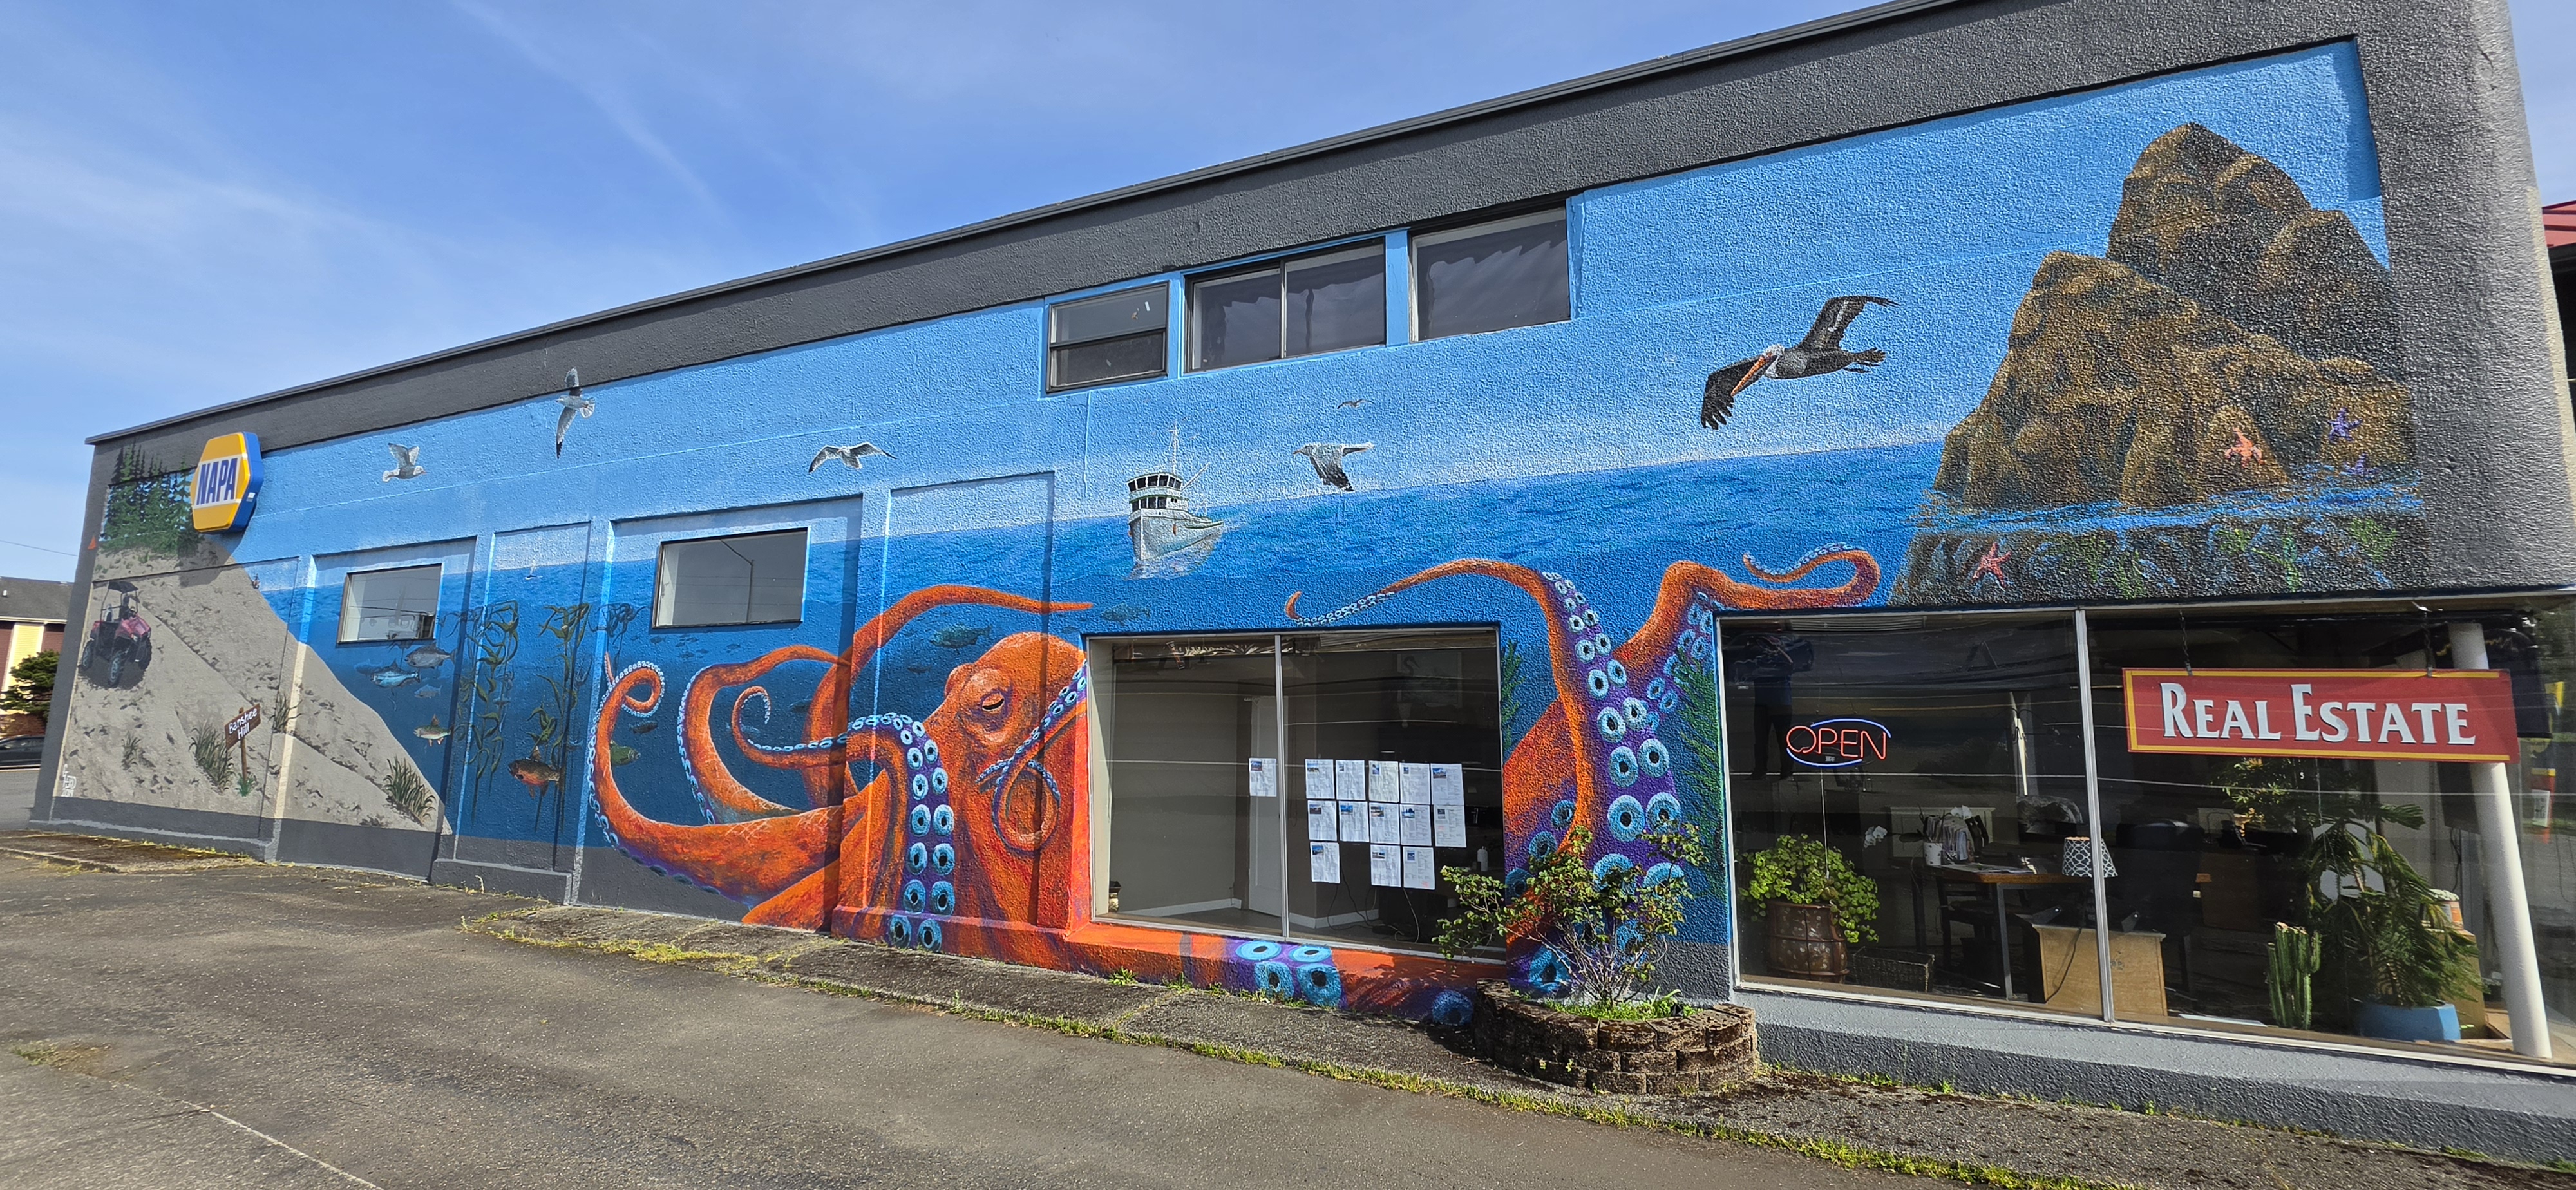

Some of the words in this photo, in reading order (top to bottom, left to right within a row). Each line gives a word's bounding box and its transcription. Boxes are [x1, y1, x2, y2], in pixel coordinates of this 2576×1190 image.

[196, 458, 238, 505] NAPA
[229, 708, 258, 734] Banshee
[237, 722, 250, 740] Hill
[2159, 682, 2282, 740] REAL
[2290, 683, 2476, 745] ESTATE
[1786, 725, 1887, 760] OPEN
